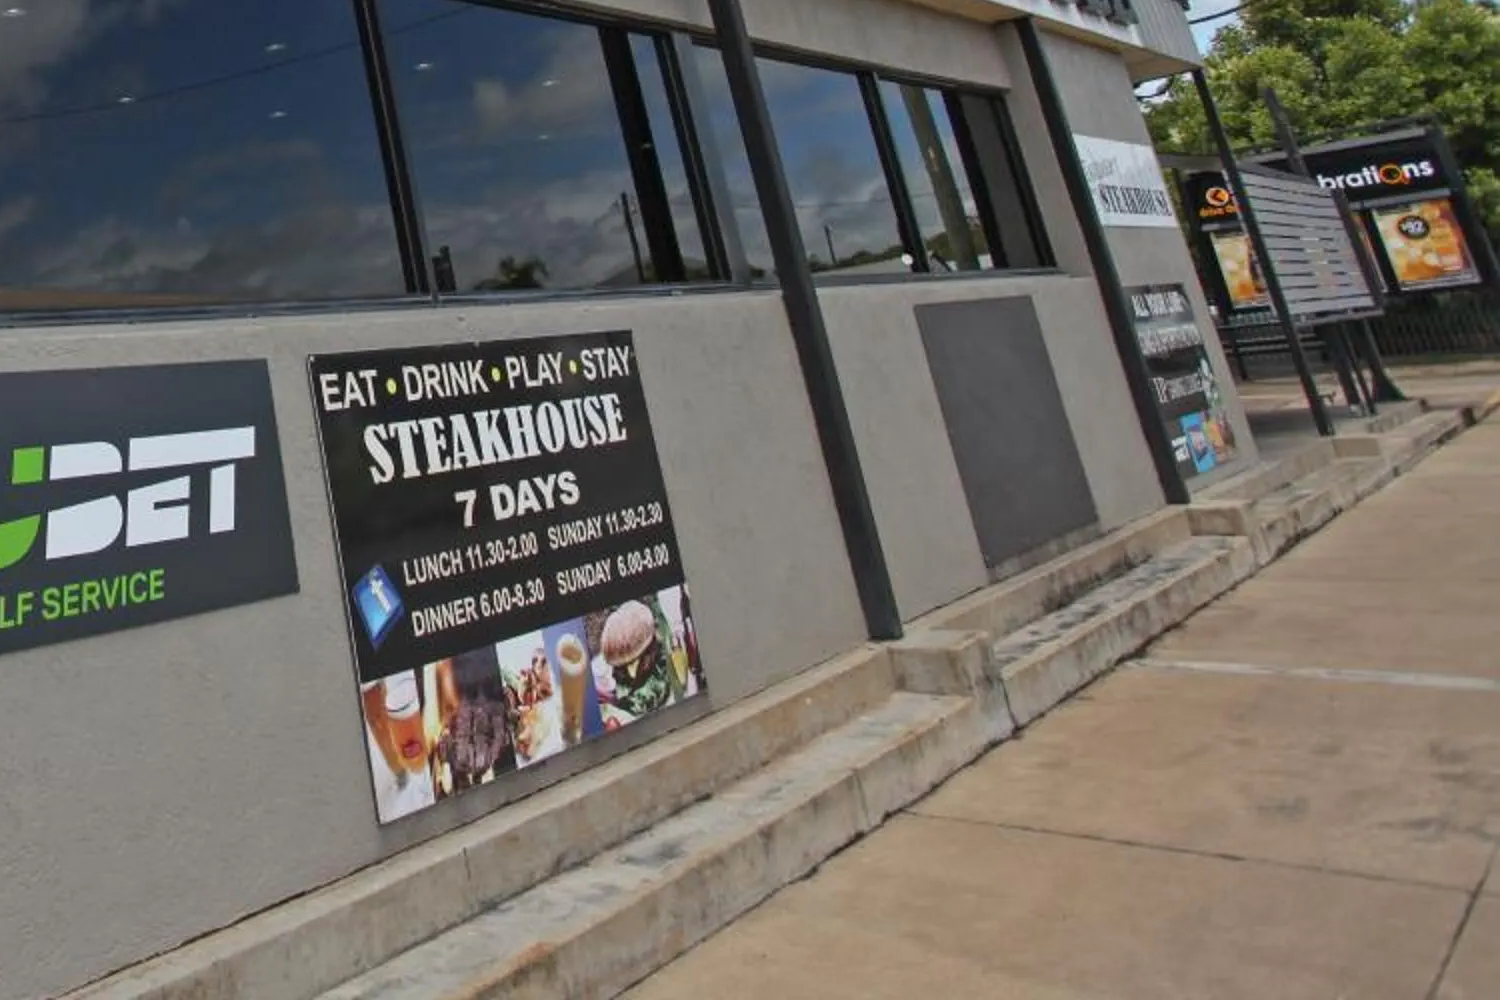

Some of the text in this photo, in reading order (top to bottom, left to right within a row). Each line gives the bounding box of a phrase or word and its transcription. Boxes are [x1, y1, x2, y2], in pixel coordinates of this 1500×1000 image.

[319, 346, 630, 411] EAT DRINK PLAY STAY
[363, 393, 628, 484] STEAKHOUSE
[454, 470, 581, 527] 7 DAYS
[403, 501, 663, 586] LUNCH 11.30-2.00 SUNDAY 11.30-2.30
[41, 568, 165, 620] SERVICE
[411, 543, 669, 637] DINNER 6.00-8.30 SUNDAY 6.00-8.00
